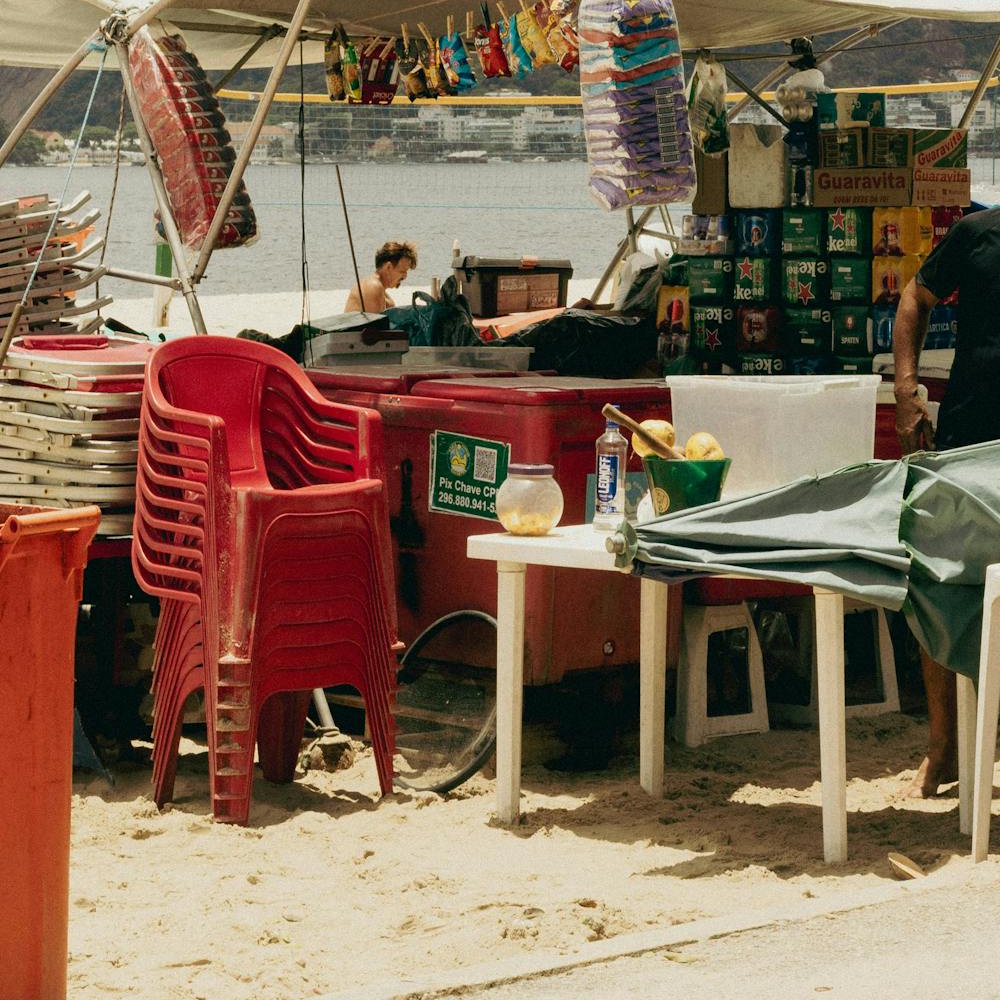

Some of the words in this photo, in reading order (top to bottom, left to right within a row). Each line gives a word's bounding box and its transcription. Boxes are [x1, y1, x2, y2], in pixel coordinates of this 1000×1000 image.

[917, 131, 963, 166] Guaravita
[817, 172, 906, 190] Guaravita
[913, 169, 969, 183] Guaravita
[439, 476, 453, 489] Pix
[454, 480, 482, 495] Chave
[598, 456, 611, 494] LEONOFF
[438, 491, 497, 514] 296.880.941-5
